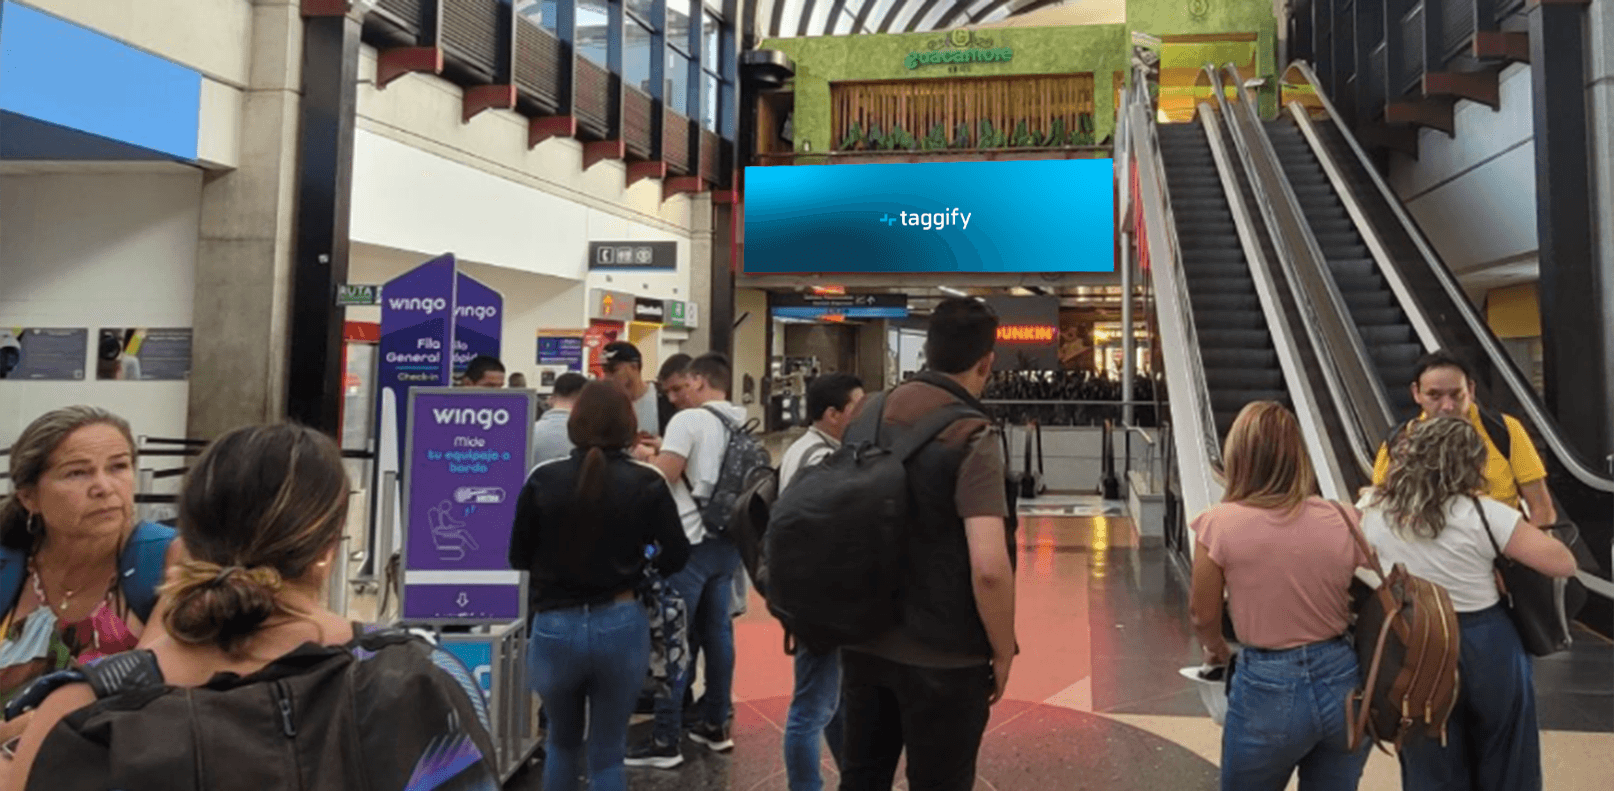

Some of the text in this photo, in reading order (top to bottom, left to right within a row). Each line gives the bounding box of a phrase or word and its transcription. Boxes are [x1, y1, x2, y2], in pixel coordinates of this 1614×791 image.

[904, 47, 1013, 69] guacamole
[899, 207, 971, 230] taggify
[388, 297, 446, 314] wingo
[417, 337, 441, 349] Fila
[386, 352, 440, 363] General
[433, 408, 510, 430] wingo
